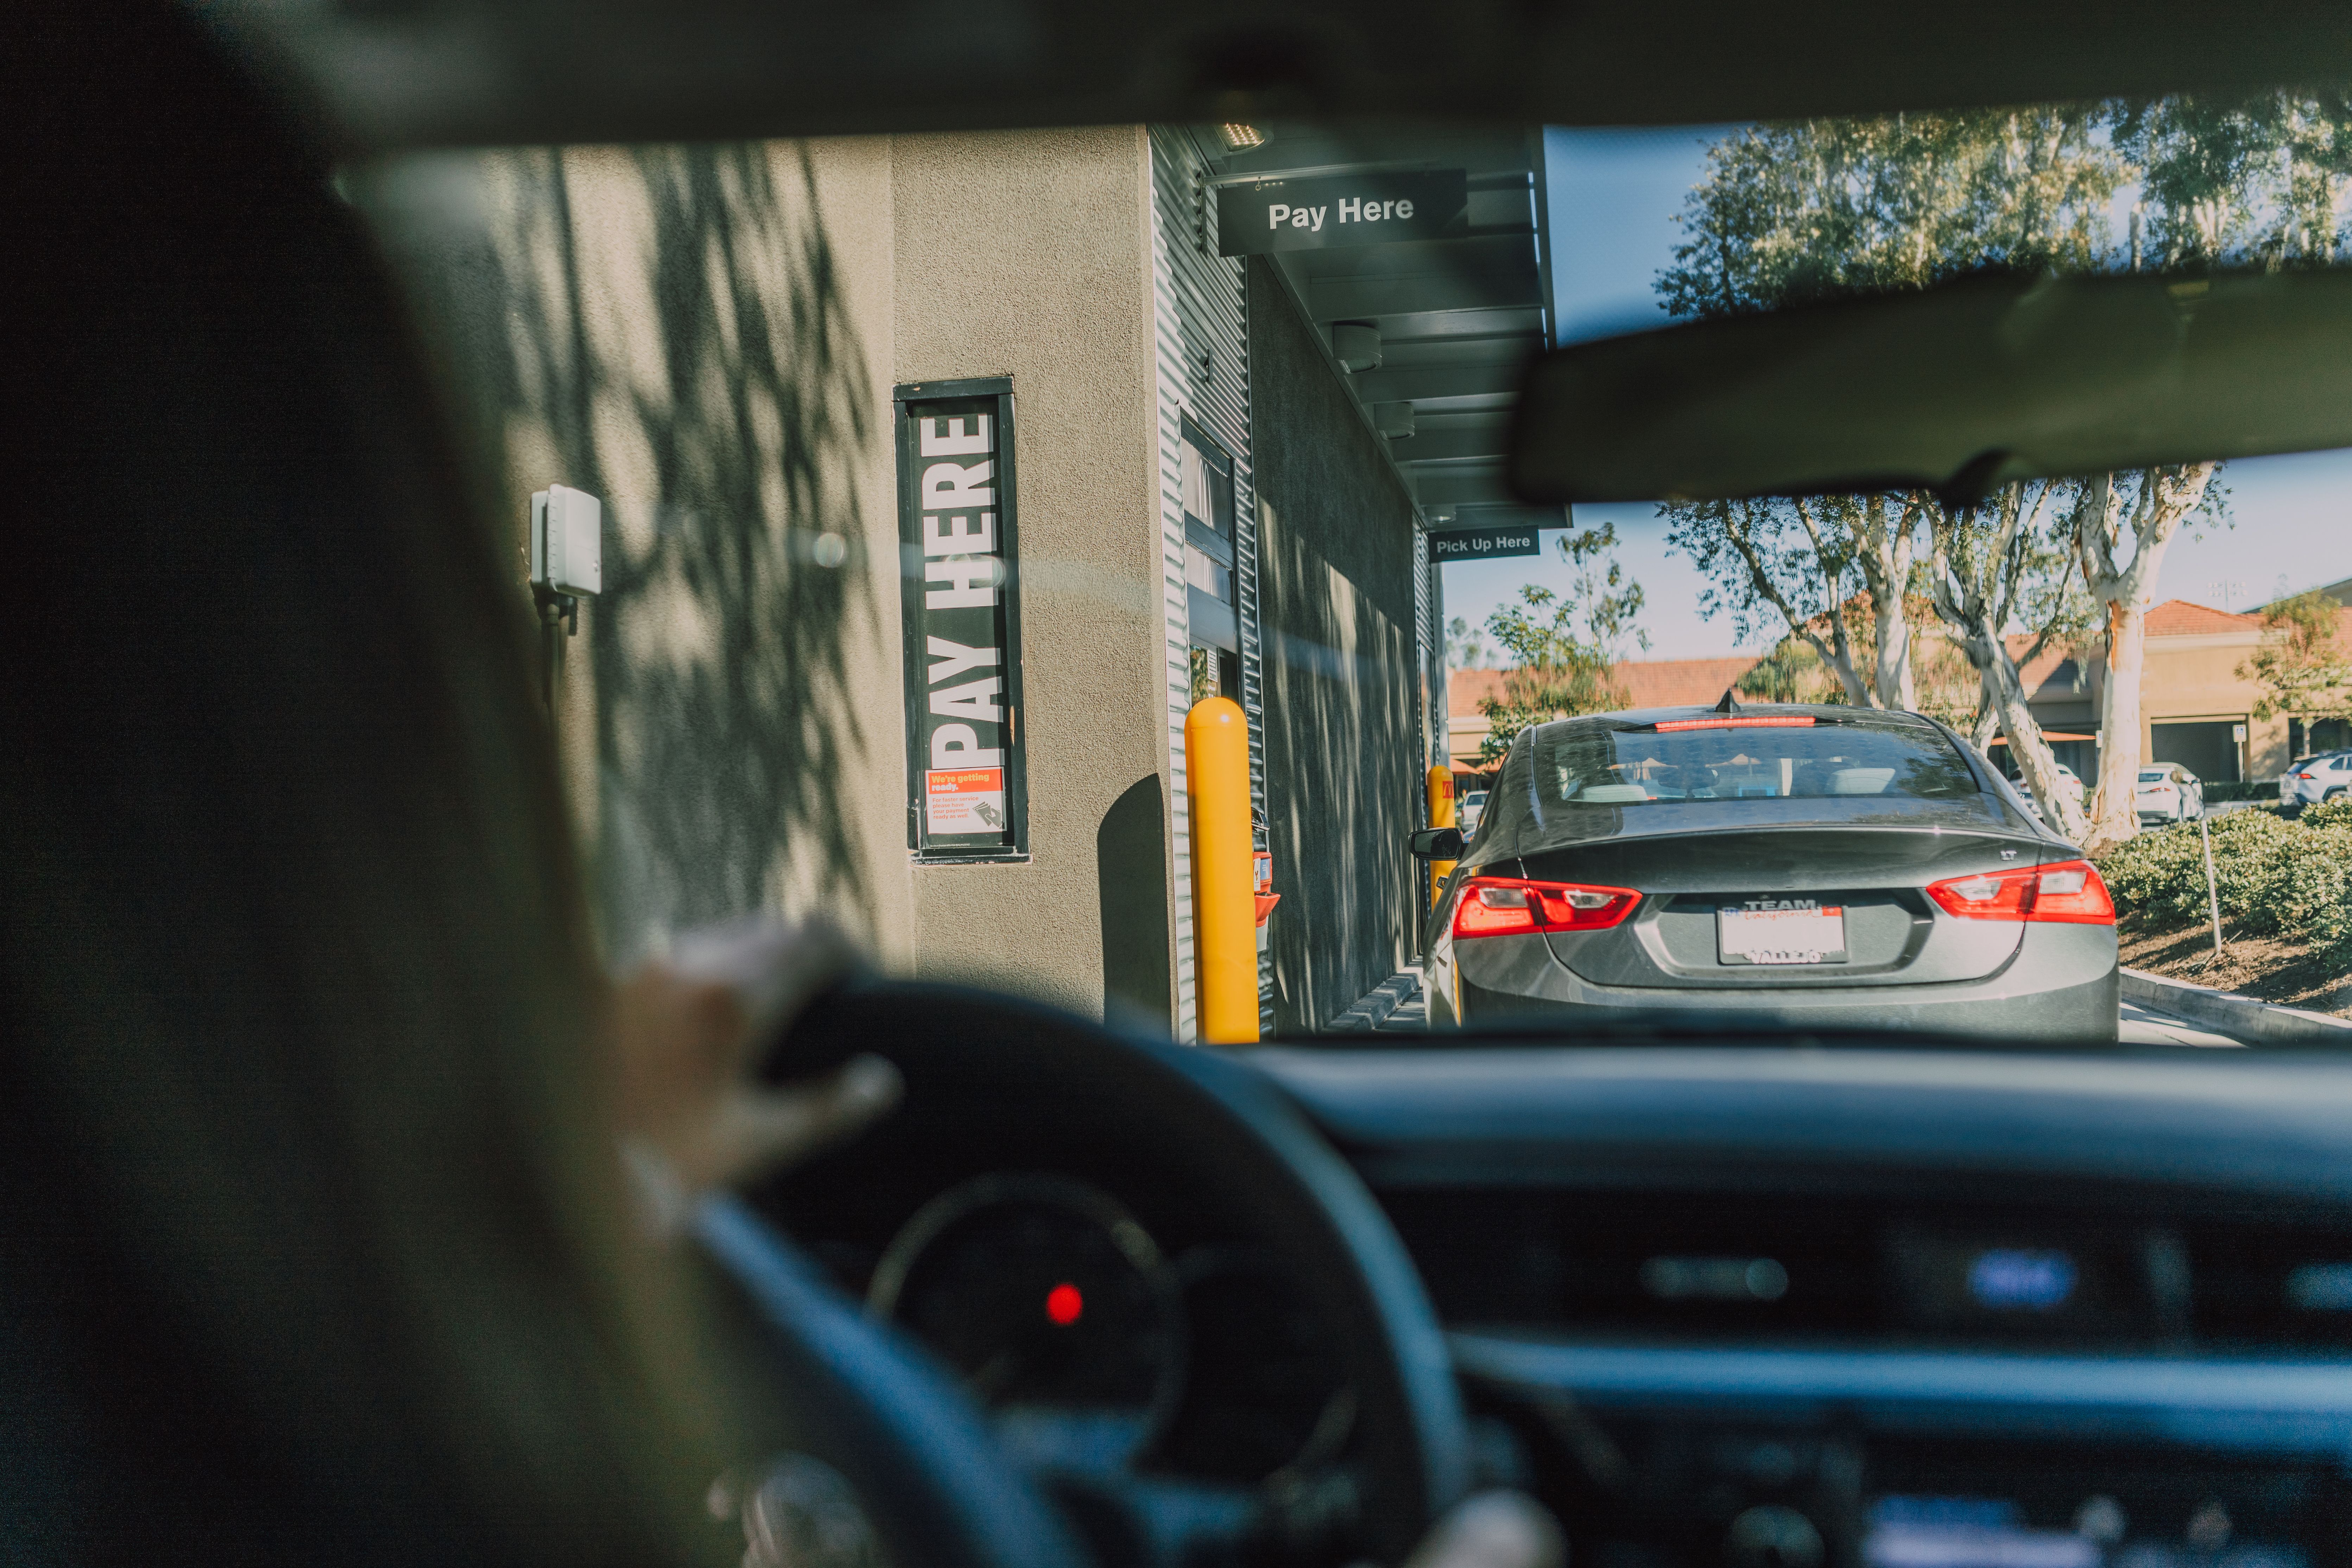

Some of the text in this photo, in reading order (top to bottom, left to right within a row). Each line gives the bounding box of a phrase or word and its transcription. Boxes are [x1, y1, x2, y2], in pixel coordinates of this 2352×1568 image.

[1269, 197, 1414, 232] Pay Here
[920, 414, 999, 609] HERE
[1437, 537, 1530, 553] Pick Up Here
[927, 636, 1004, 770] PAY
[957, 773, 989, 783] getting
[932, 783, 959, 791] ready.
[2000, 850, 2017, 860] LT
[1745, 900, 1816, 911] TEAM
[1751, 951, 1821, 964] VALLEJO
